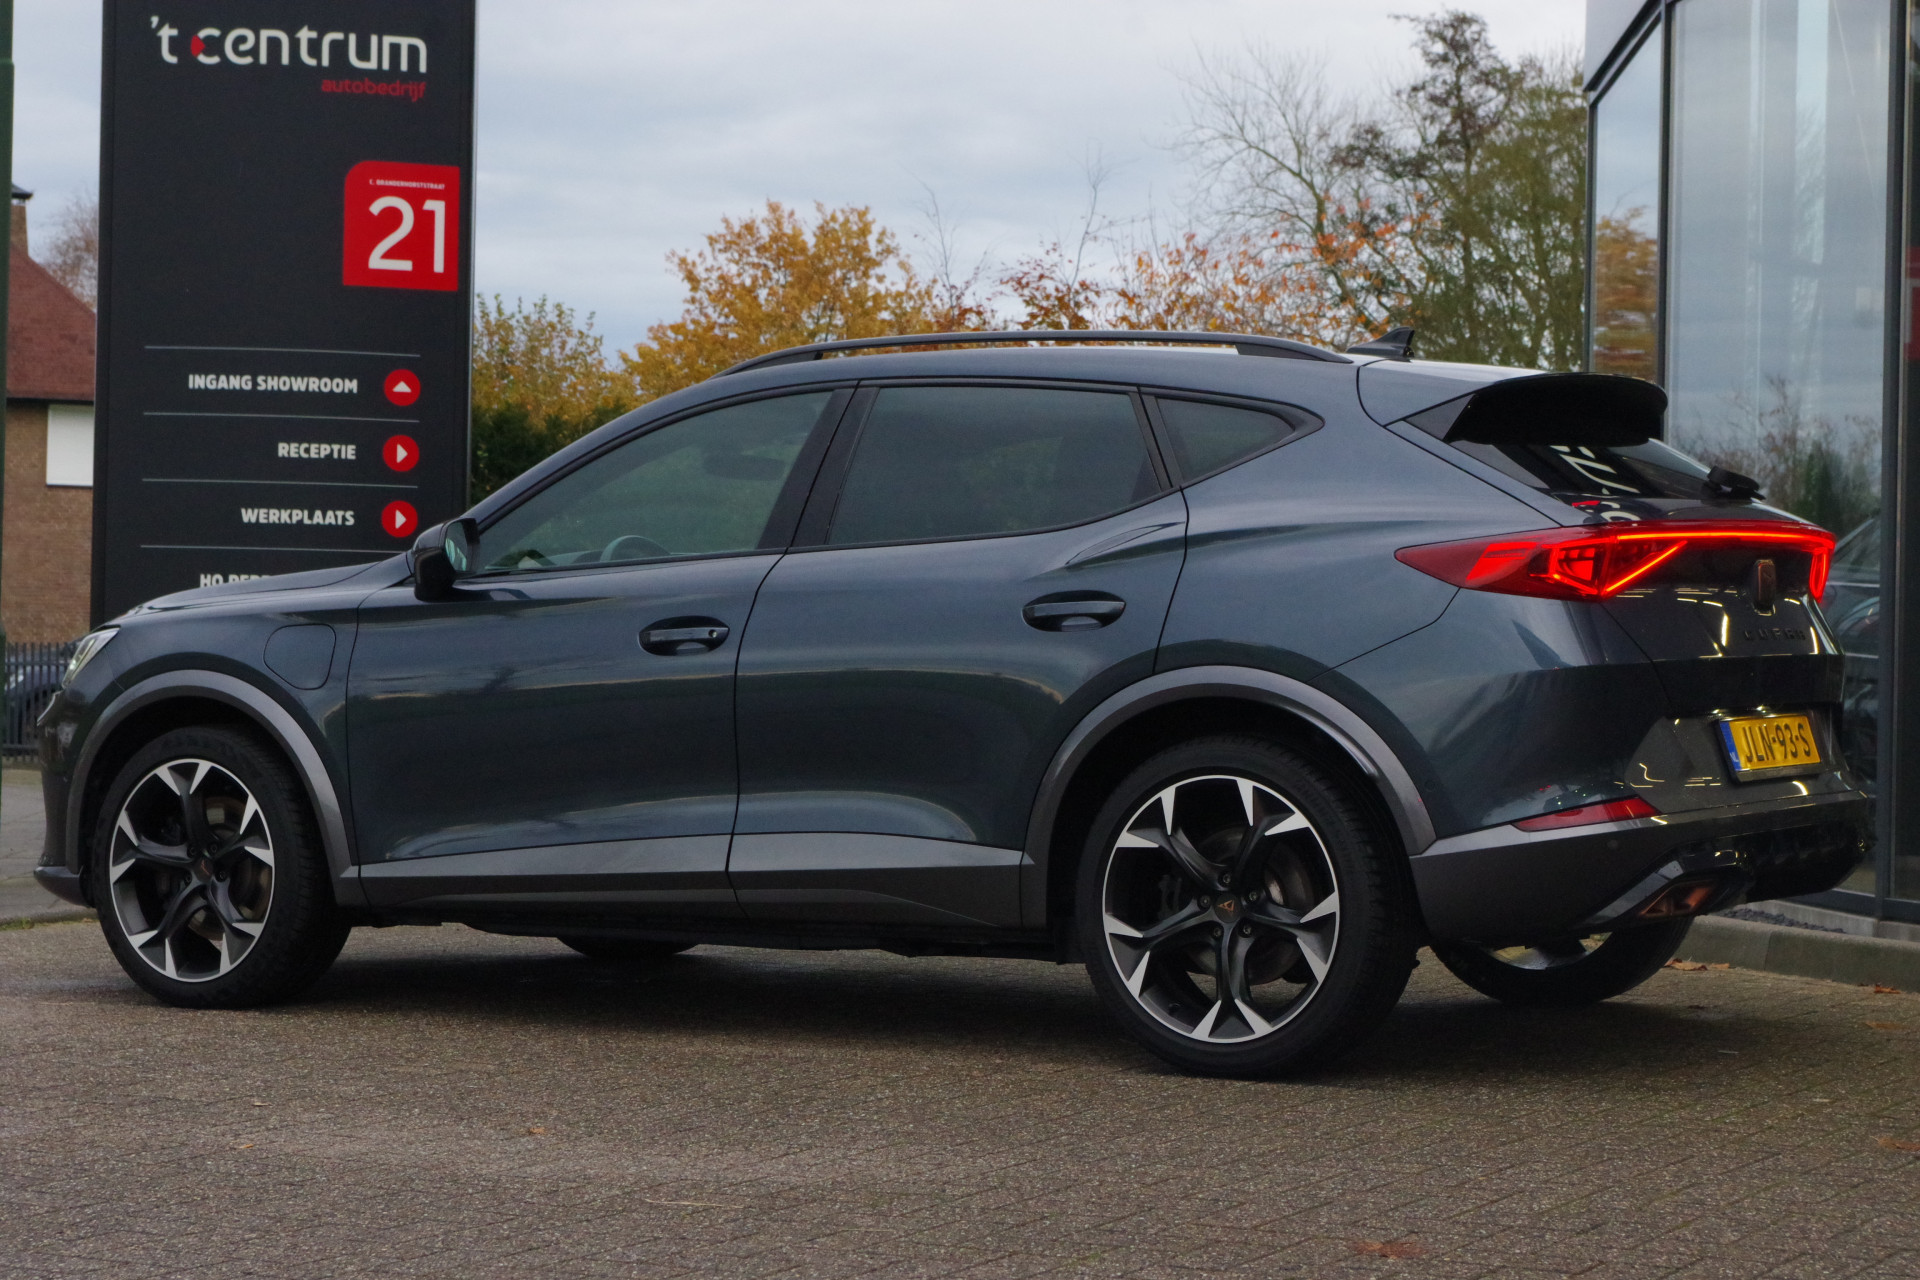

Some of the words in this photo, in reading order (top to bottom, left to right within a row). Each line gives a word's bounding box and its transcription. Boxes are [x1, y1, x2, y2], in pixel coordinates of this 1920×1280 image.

[189, 24, 428, 74] centrum
[321, 77, 427, 102] autobedrijf
[368, 195, 446, 274] 21
[188, 373, 253, 391] INGANG
[256, 375, 358, 394] SHOWROOM
[277, 442, 357, 460] RECEPTIE
[240, 507, 355, 526] WERKPLAATS
[1742, 723, 1811, 763] JLN-93-S
